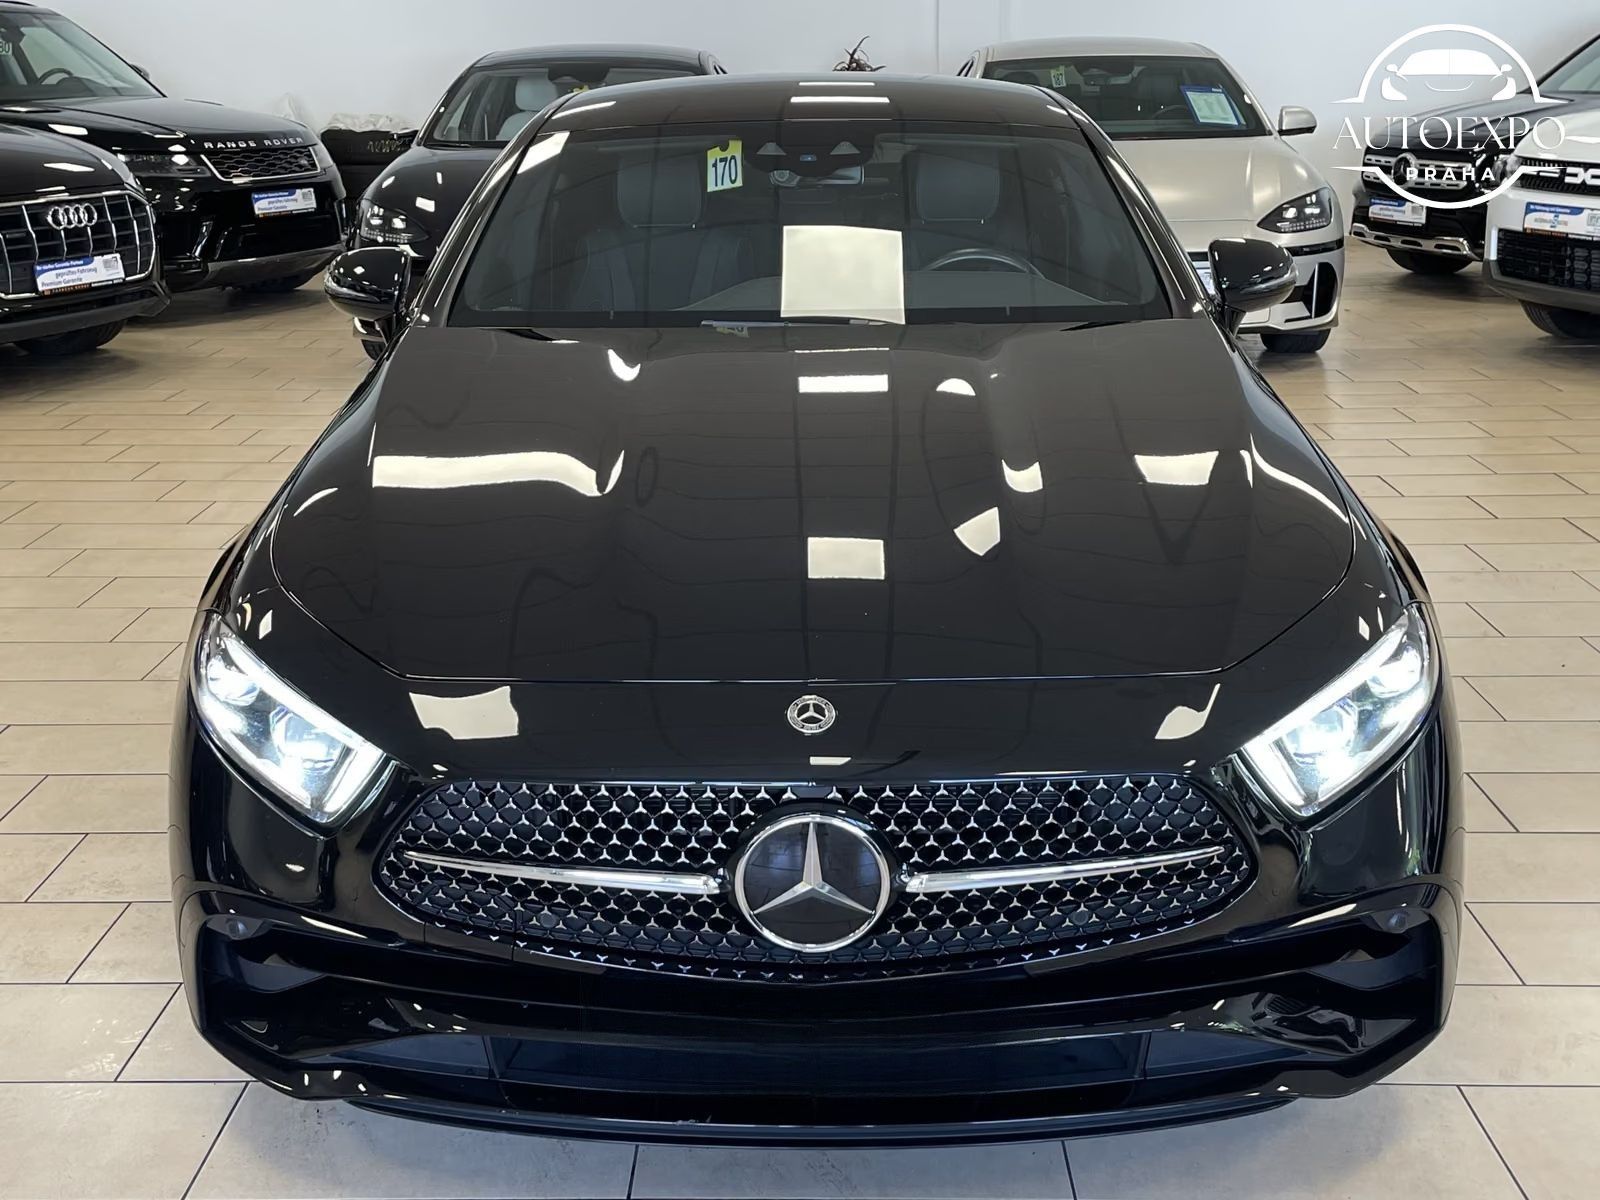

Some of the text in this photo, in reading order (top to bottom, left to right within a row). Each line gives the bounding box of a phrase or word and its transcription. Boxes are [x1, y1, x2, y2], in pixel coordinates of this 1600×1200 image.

[203, 137, 304, 149] RANGE ROVER
[712, 154, 738, 187] 170
